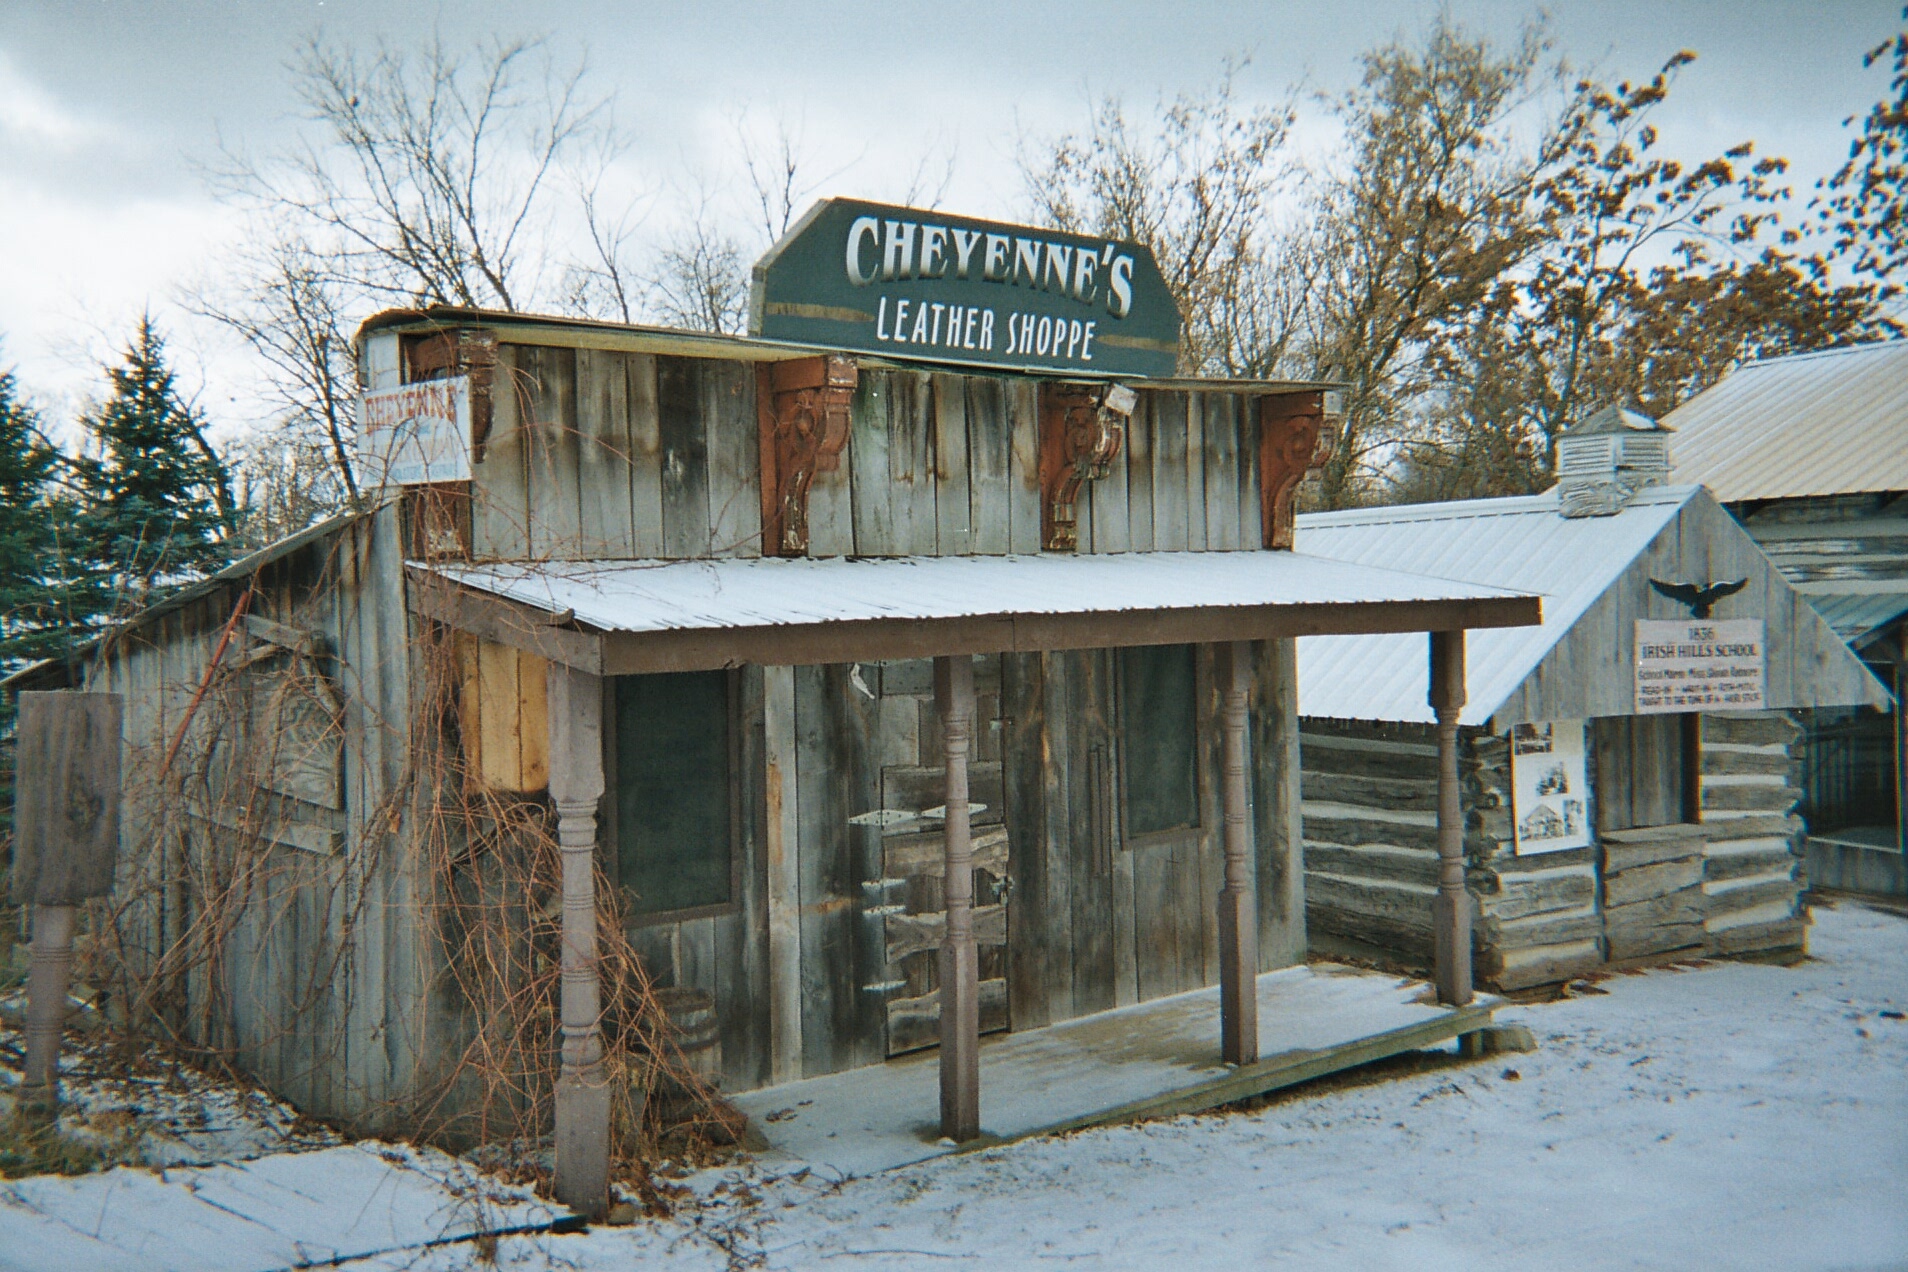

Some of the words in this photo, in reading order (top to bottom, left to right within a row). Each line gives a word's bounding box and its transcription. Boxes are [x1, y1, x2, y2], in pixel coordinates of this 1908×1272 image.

[846, 216, 1135, 320] CHEYENNE'S
[876, 295, 995, 352] LEATHER
[1005, 312, 1096, 361] SHOPPE
[1642, 645, 1676, 659] IRISH
[1678, 644, 1713, 658] HILLS
[1715, 643, 1758, 657] SCHOOL
